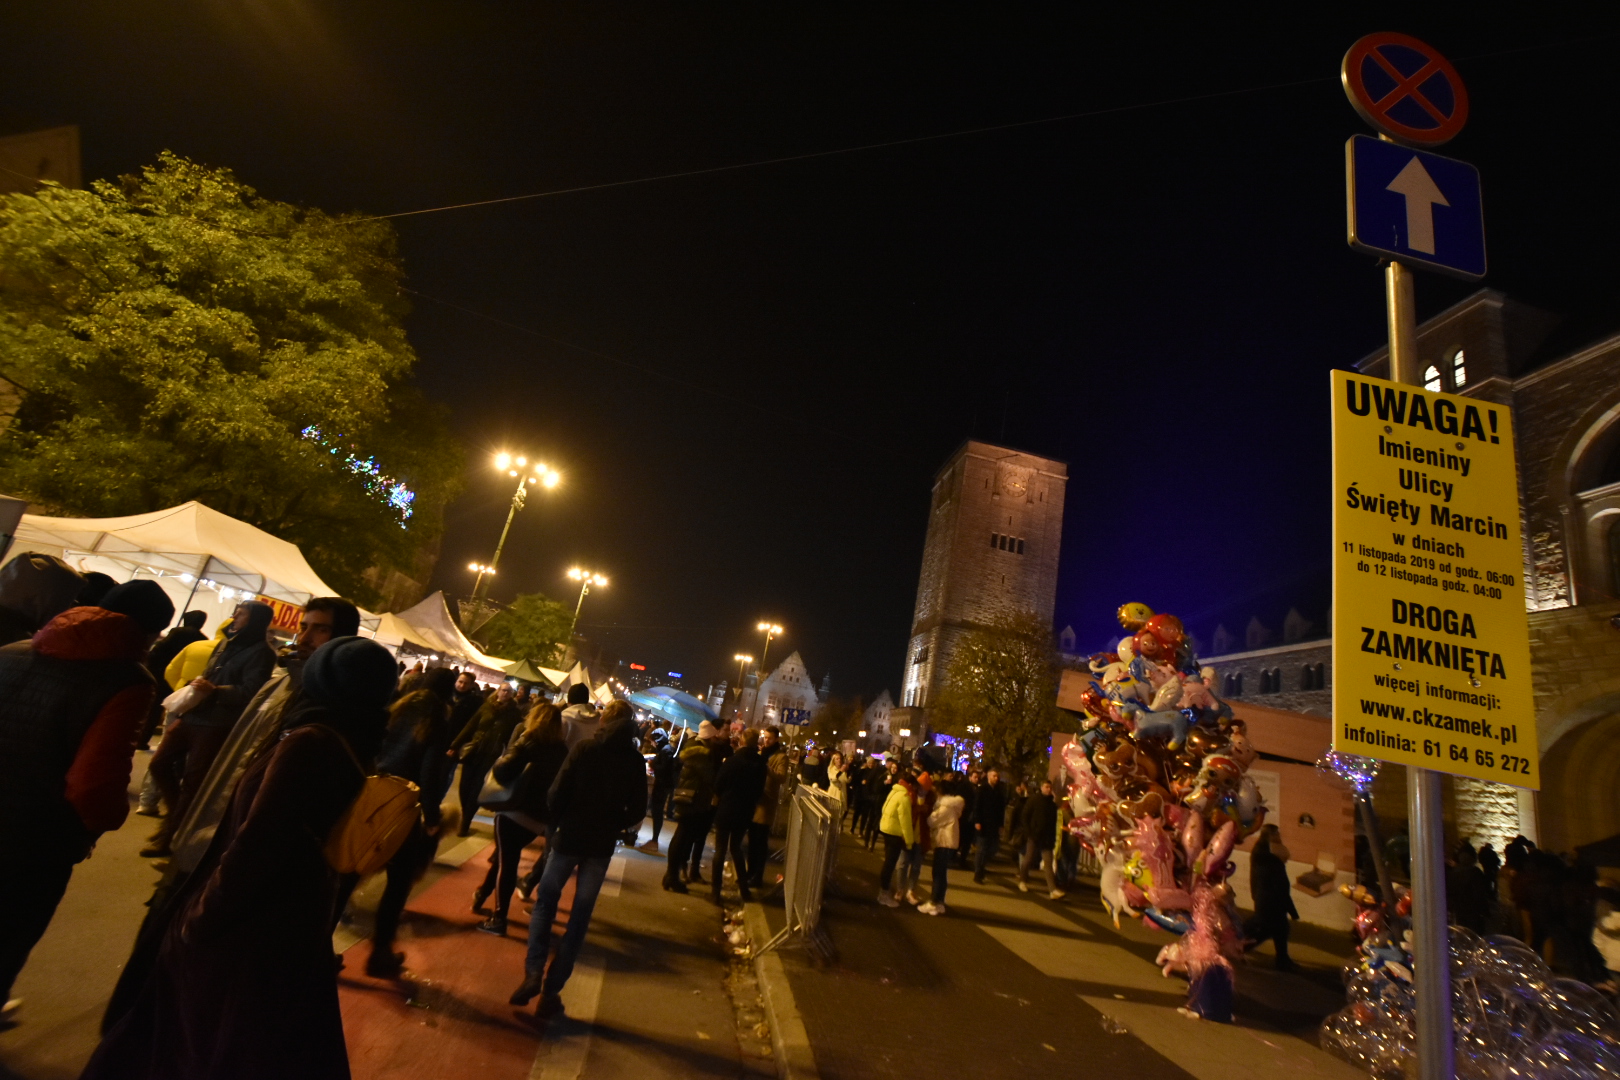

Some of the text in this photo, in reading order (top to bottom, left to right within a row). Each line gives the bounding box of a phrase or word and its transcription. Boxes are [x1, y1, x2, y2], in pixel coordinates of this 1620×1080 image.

[1346, 379, 1499, 444] UWAGA!
[1379, 435, 1470, 476] Imieniny
[1399, 468, 1453, 502] Ulicy
[1347, 482, 1507, 540] Święty Marcin
[1343, 542, 1514, 586] 11 listopada 2019 od godz. 06:00
[1393, 533, 1465, 558] w dniach
[1358, 561, 1502, 599] do 12 listopada godz. 04:00
[1392, 598, 1477, 639] DROGA
[1361, 627, 1506, 679] ZAMKNIĘTA
[1374, 674, 1500, 711] więcej informacji:
[1360, 699, 1517, 745] www.ckzamek.pl
[1345, 724, 1530, 774] infolinia: 61 64 65 272
